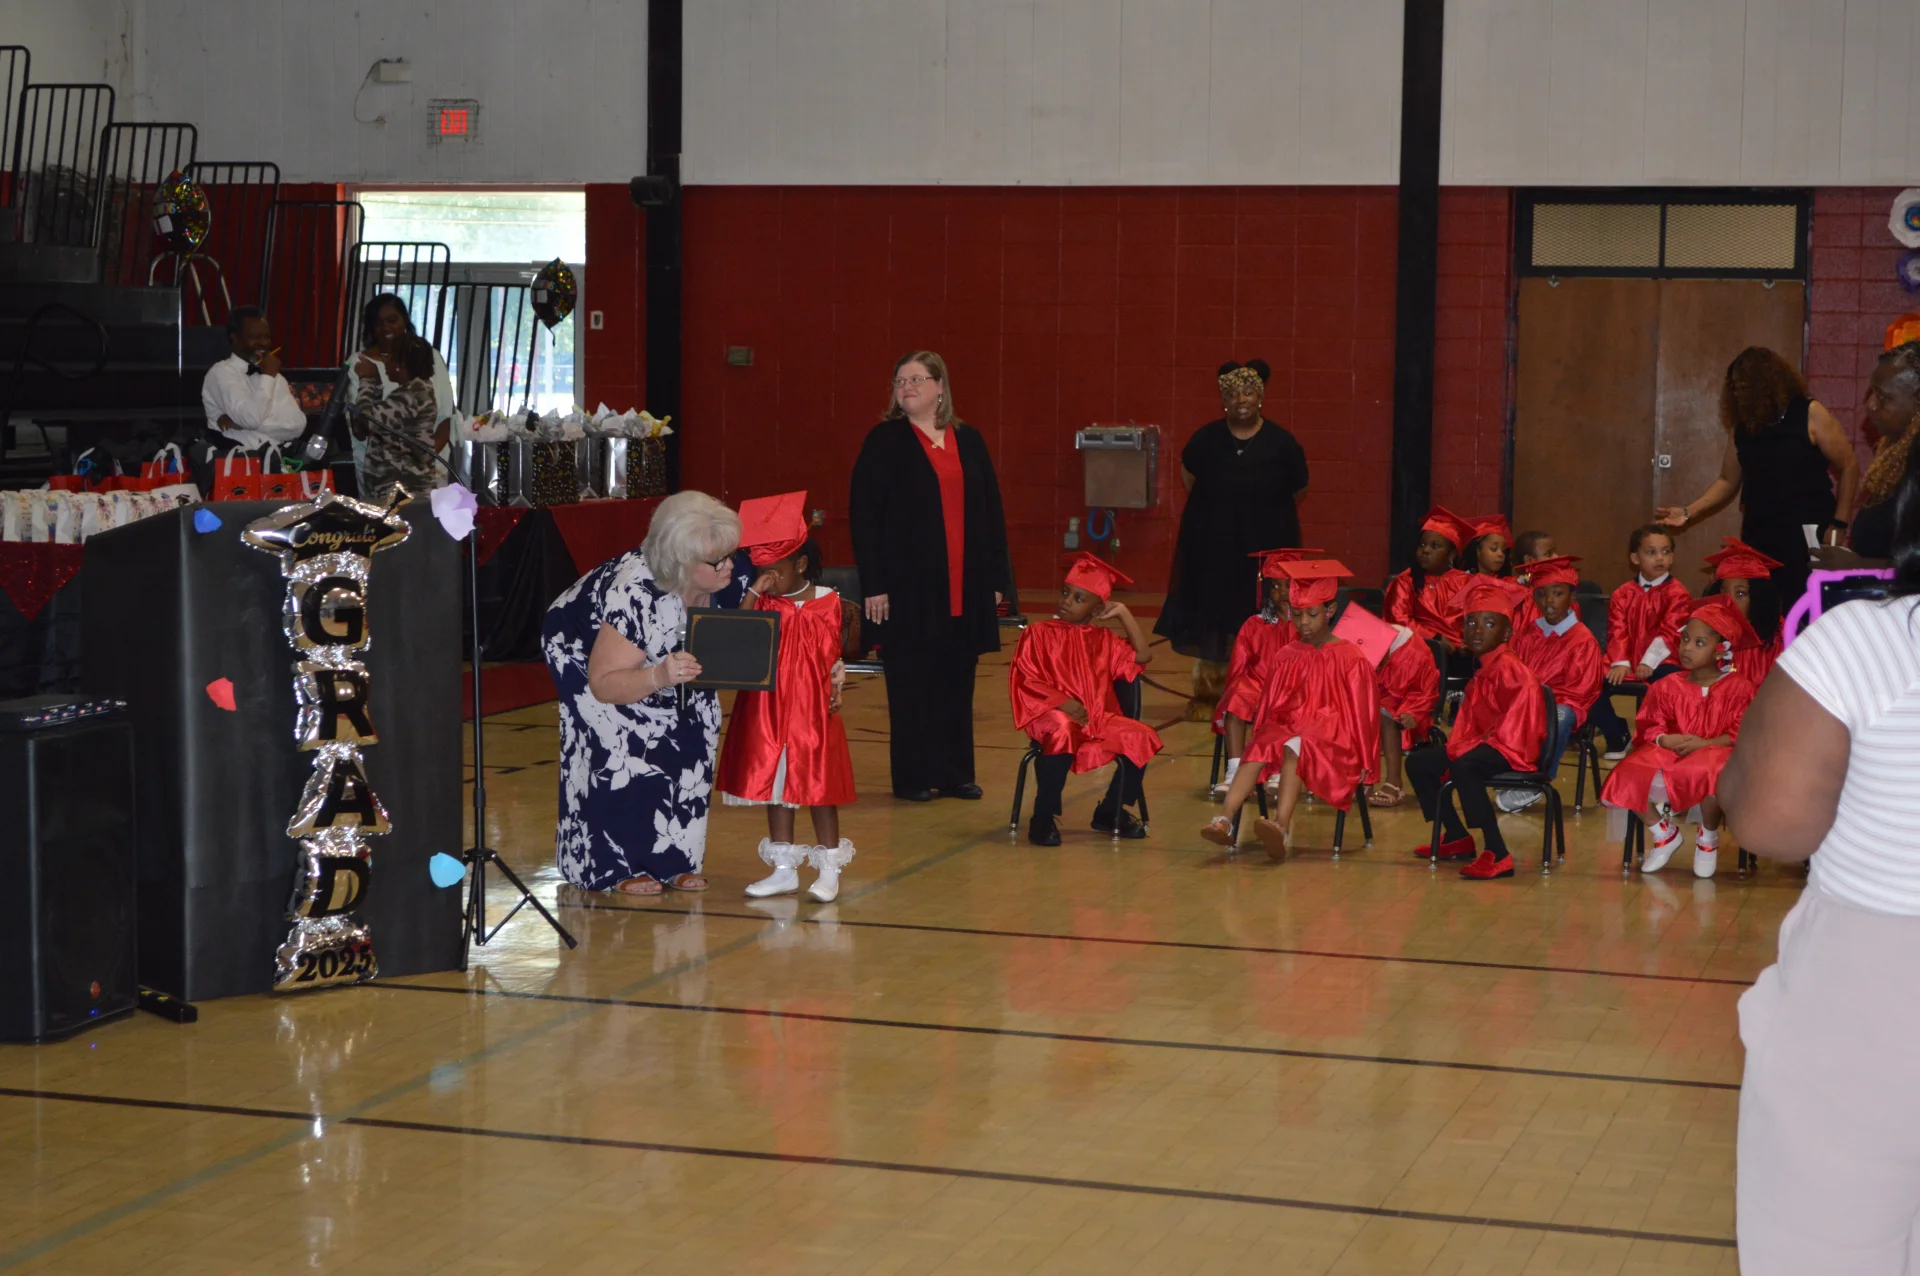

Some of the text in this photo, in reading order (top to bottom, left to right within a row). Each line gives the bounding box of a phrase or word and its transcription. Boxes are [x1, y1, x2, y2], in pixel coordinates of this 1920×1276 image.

[441, 109, 467, 134] EXIT
[288, 521, 377, 551] Congrats
[295, 942, 372, 982] 2025
